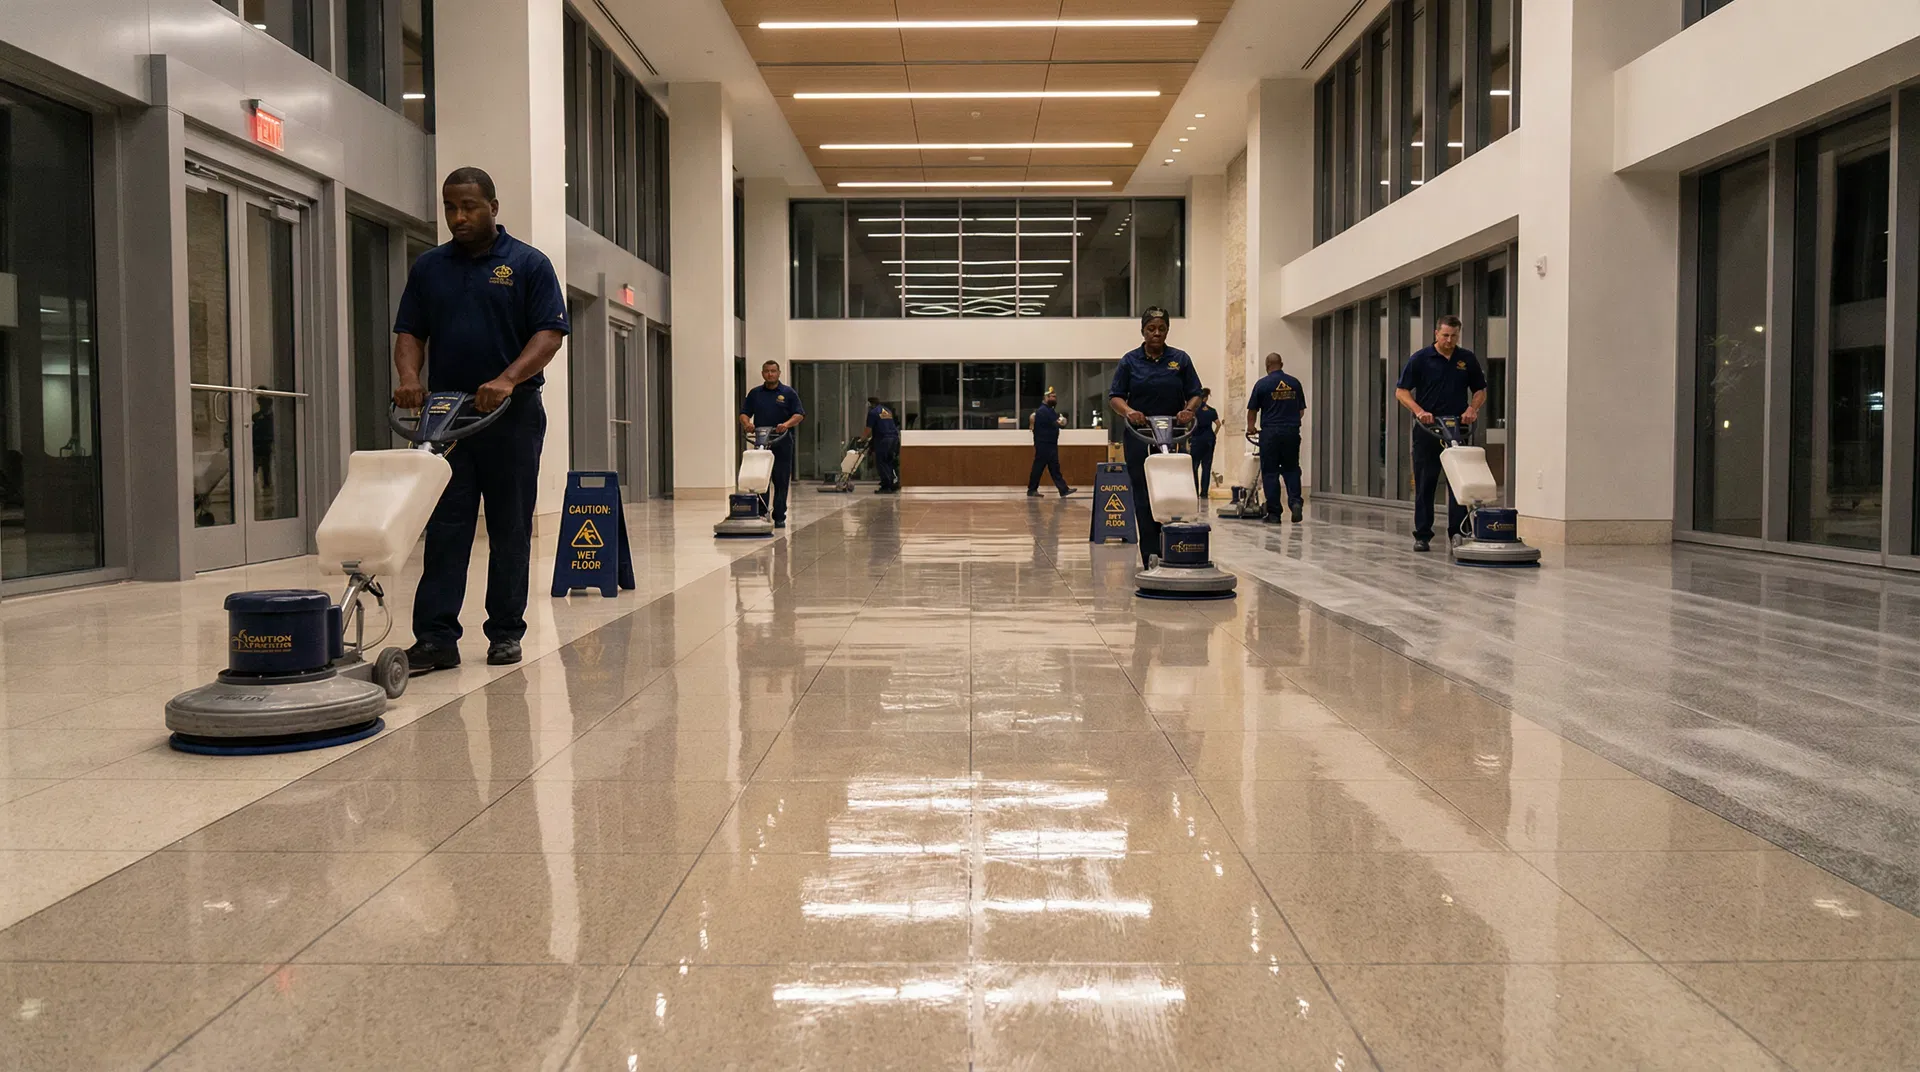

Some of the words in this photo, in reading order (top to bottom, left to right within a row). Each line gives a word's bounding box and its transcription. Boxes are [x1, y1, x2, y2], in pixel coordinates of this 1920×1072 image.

[569, 505, 611, 514] CAUTION:
[577, 550, 597, 559] WET
[571, 560, 601, 569] FLOOR
[248, 635, 292, 643] CAUTION
